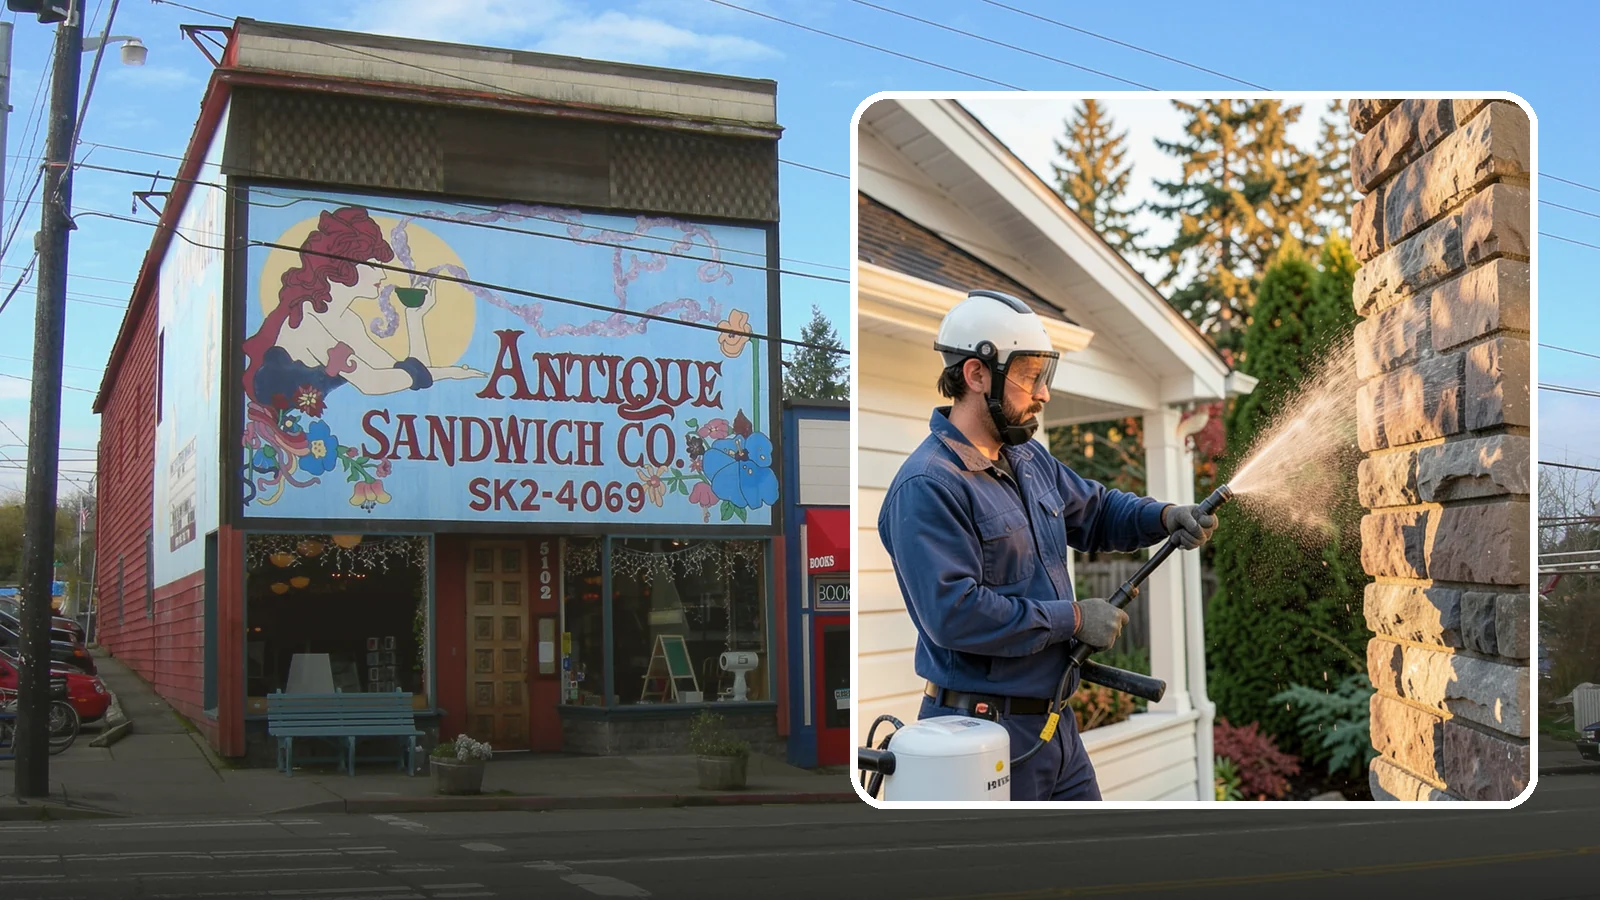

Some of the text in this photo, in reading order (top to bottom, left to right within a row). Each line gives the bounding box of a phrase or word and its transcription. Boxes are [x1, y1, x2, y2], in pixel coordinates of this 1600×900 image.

[475, 329, 723, 420] ANTIQUE
[361, 409, 685, 469] SANDWICH CO.
[468, 477, 646, 513] SK2-4069
[539, 541, 552, 600] 5102
[809, 555, 835, 569] BOOKS
